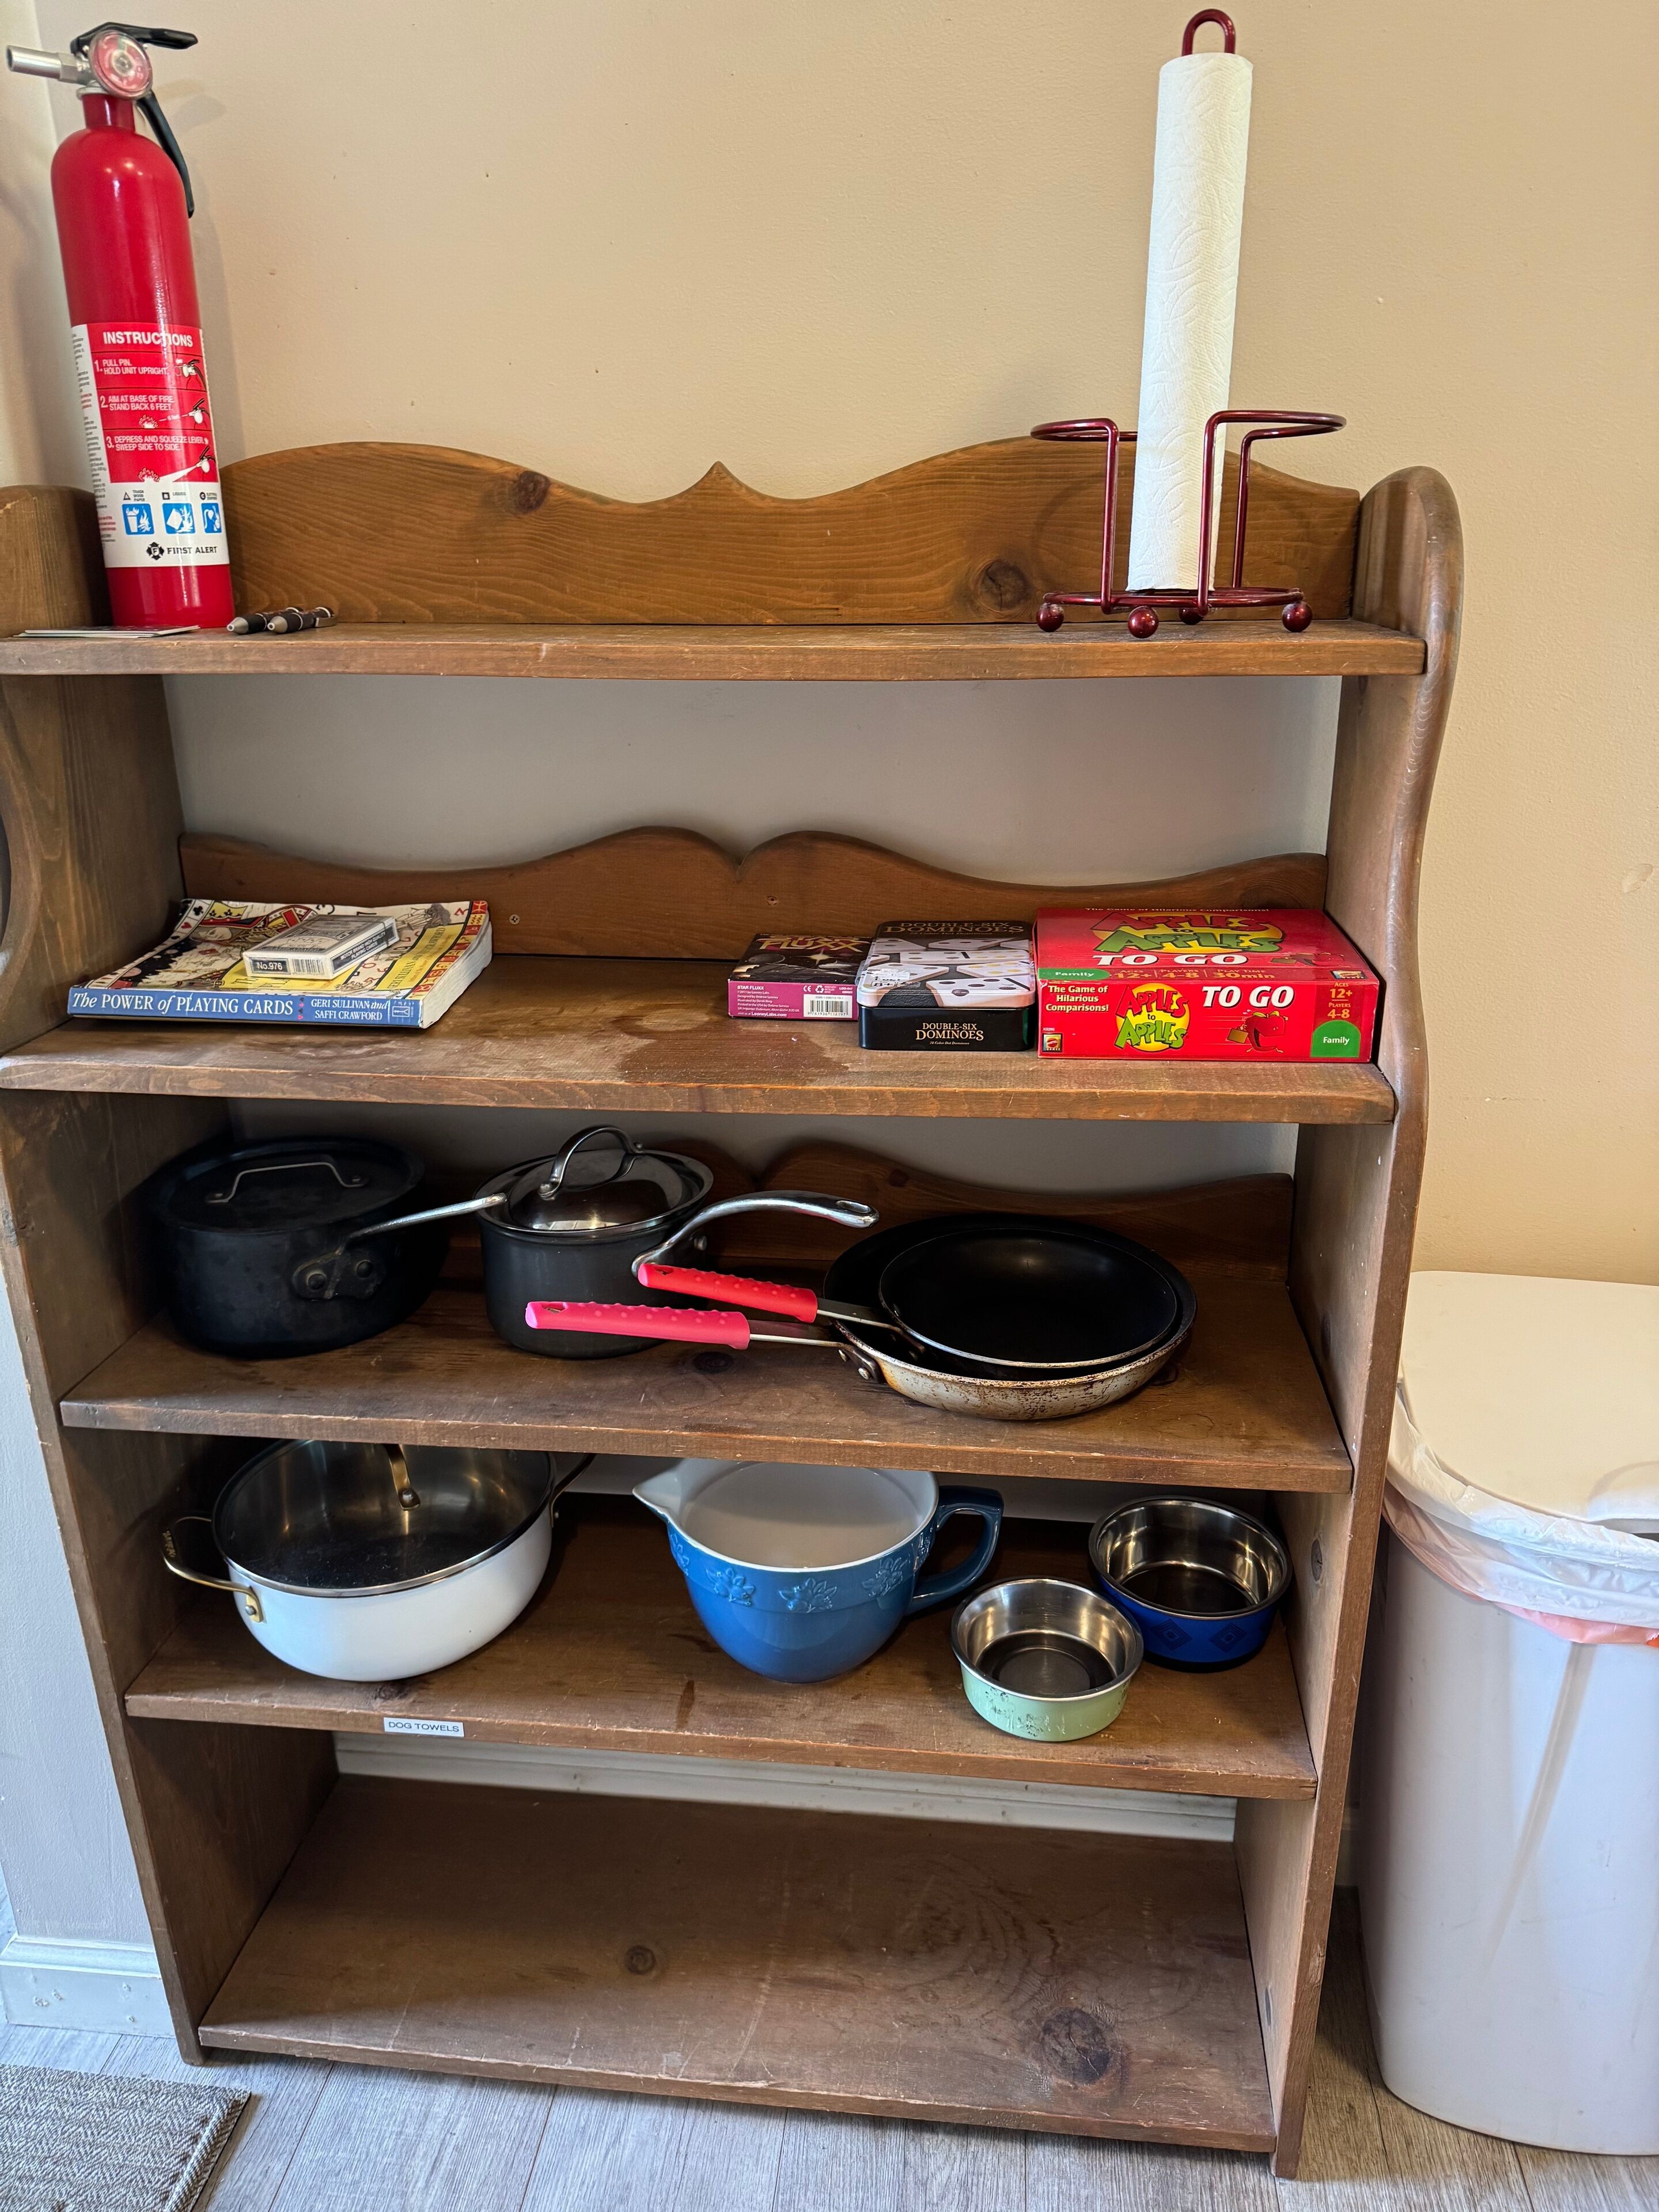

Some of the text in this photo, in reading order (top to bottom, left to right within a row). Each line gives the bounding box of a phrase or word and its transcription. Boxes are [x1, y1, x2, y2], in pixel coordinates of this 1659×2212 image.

[103, 331, 193, 347] INSTRUCTIONS
[103, 358, 119, 366] PULL
[104, 367, 120, 375] HOLD
[138, 367, 169, 375] UPRIGHT.
[115, 435, 143, 444] DEPRESS
[1090, 911, 1271, 931] APPLES
[756, 934, 870, 944] STAR
[1094, 930, 1283, 953] APPLES
[759, 940, 863, 952] FLUXX
[1093, 954, 1248, 965] TO GO
[256, 961, 283, 971] No.976
[1098, 985, 1108, 993] of
[1330, 988, 1353, 998] 12+
[1115, 984, 1189, 1018] APPLES
[1202, 986, 1294, 1007] TO GO
[73, 993, 293, 1015] The POWER of PLAYING CARDS
[311, 999, 331, 1007] GERI
[332, 999, 370, 1009] SULLIVAN
[370, 1001, 388, 1009] and
[1046, 1003, 1109, 1013] Comparisons!
[315, 1010, 383, 1021] SAFFI CRAWFORD
[915, 1029, 984, 1041] DOMINOES
[1114, 1016, 1188, 1049] APPLES
[1323, 1036, 1350, 1046] Family
[414, 1723, 460, 1732] TOWELS
